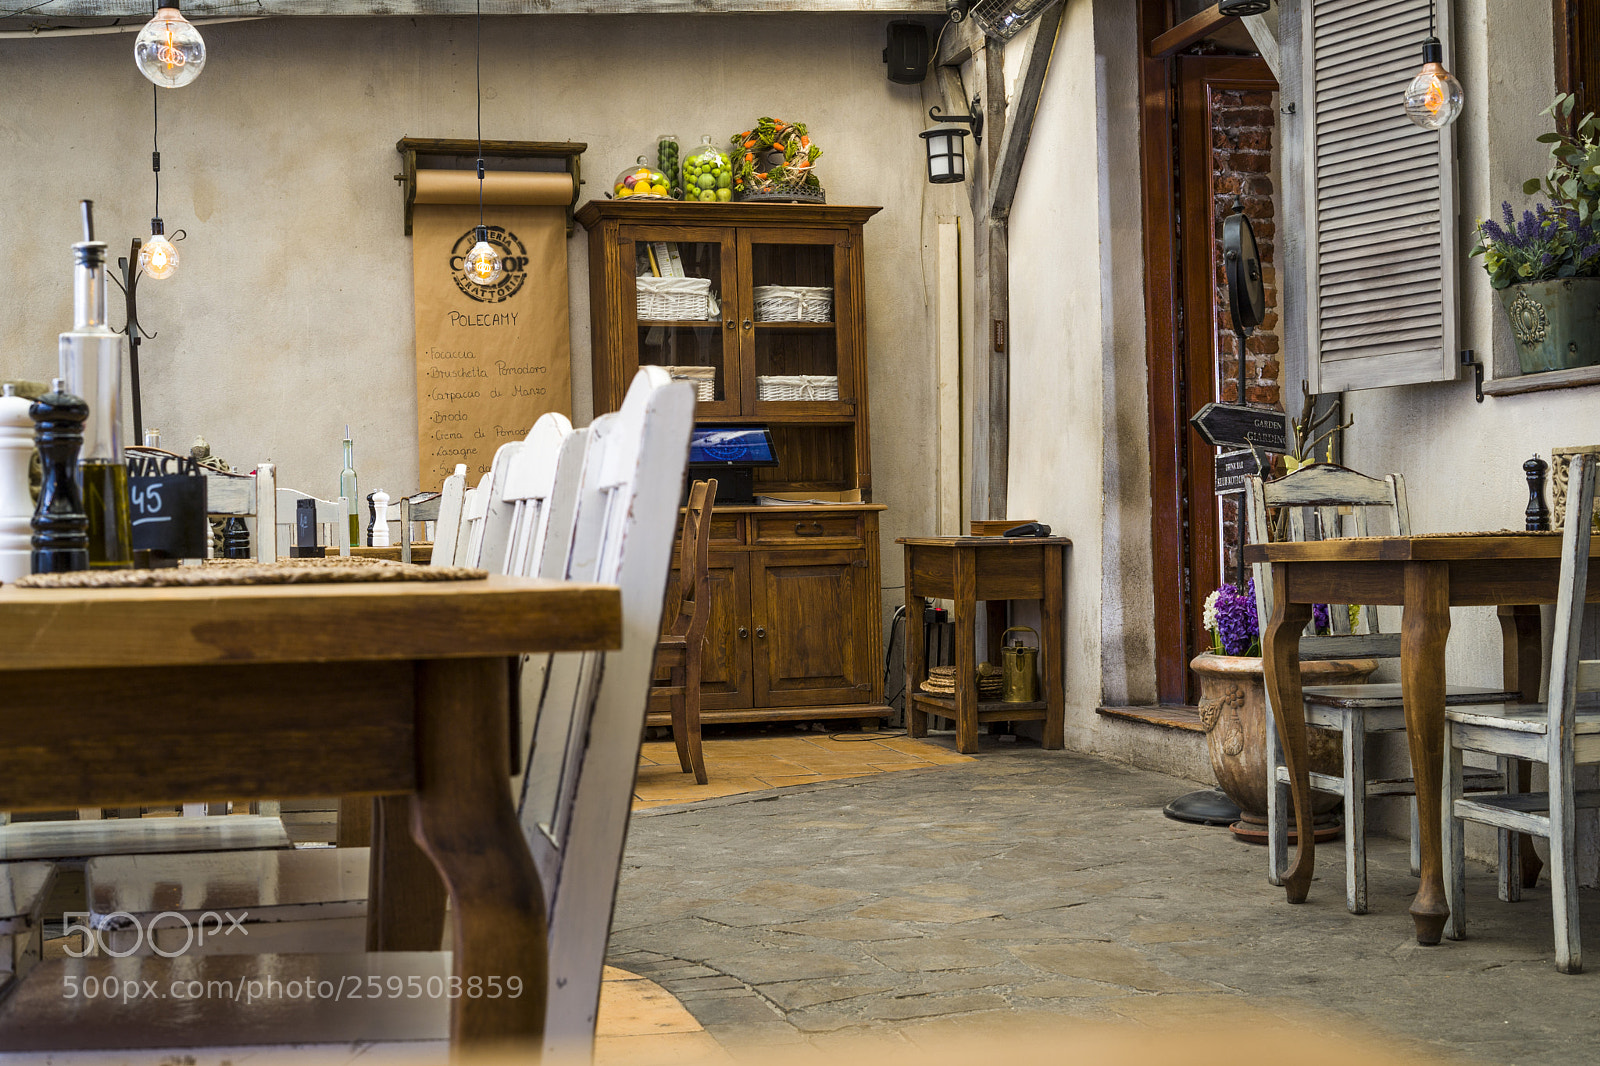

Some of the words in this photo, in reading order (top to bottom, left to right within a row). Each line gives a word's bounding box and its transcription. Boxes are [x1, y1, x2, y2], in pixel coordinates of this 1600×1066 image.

[466, 230, 512, 248] PIERIA
[449, 255, 529, 272] COP
[459, 273, 521, 298] TRATTORIA
[447, 310, 519, 327] POLECAMY
[430, 346, 476, 360] Focaccia
[430, 366, 489, 379] Bruschetta
[494, 359, 547, 376] Pomodoro
[432, 387, 481, 403] Carpaccio
[489, 387, 502, 398] di
[511, 384, 547, 397] Manzo
[433, 410, 468, 424] Brodo
[1253, 419, 1282, 430] GARDEN
[435, 429, 463, 441] Crema
[473, 428, 486, 439] di
[493, 425, 530, 437] Pomodo
[436, 447, 478, 460] Lasagne
[124, 456, 201, 477] WACJA
[131, 483, 163, 514] 45
